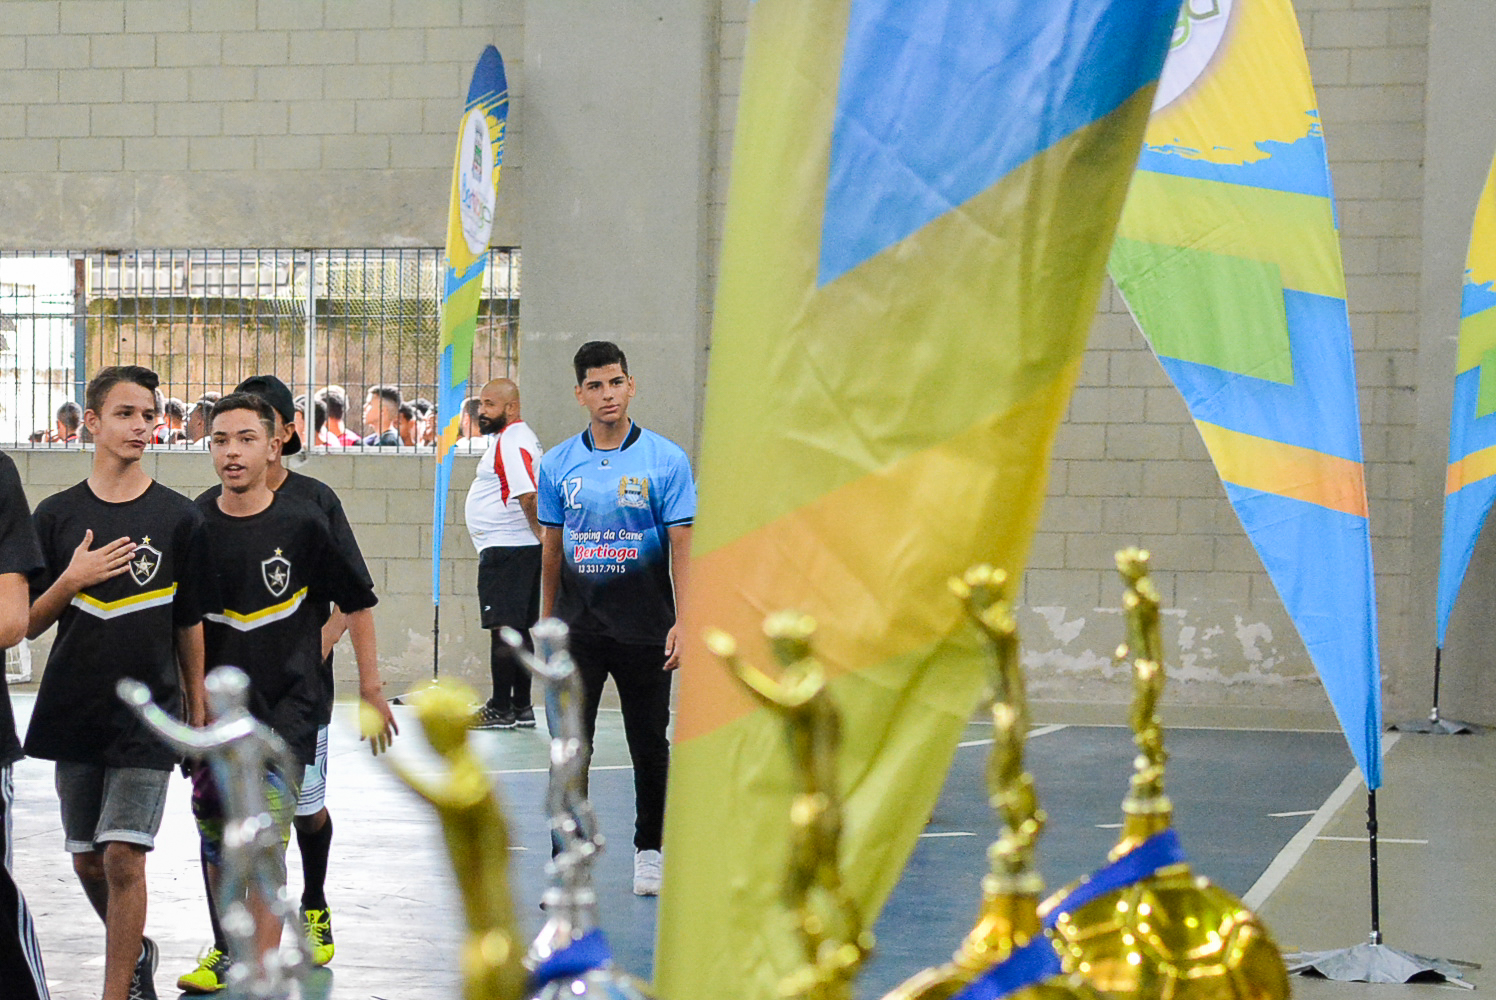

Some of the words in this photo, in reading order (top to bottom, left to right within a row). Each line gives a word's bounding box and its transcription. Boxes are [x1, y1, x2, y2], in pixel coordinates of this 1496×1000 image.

[560, 476, 582, 510] 12
[603, 529, 616, 541] da
[618, 528, 644, 541] Carne
[573, 543, 638, 563] Bertioga
